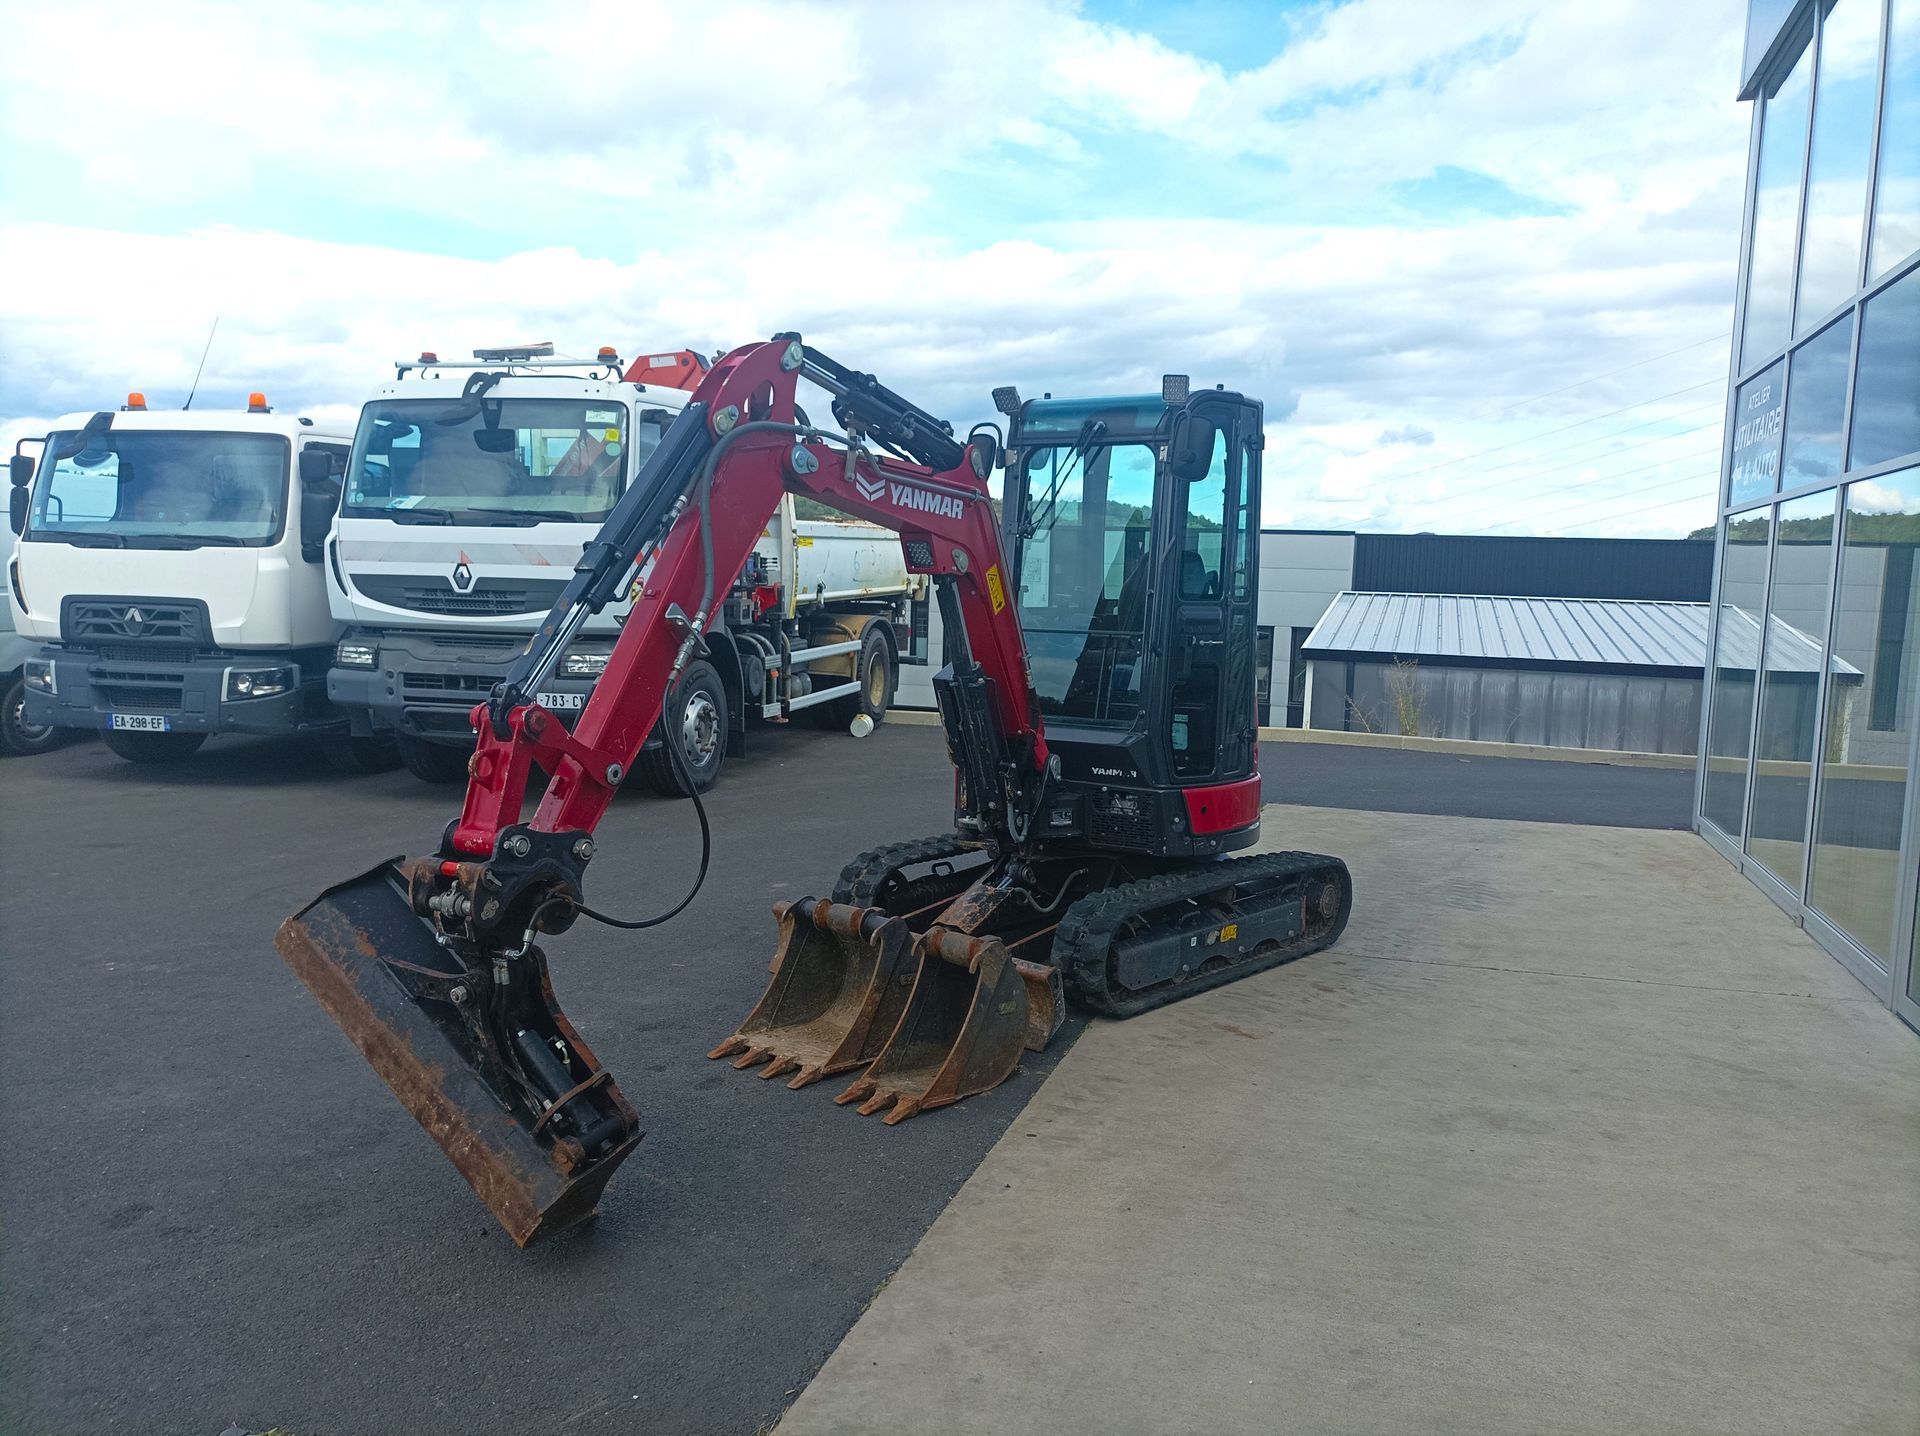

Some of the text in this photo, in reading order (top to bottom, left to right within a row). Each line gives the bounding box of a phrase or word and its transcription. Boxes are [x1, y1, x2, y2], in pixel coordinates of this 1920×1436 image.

[1734, 406, 1782, 452] UTILITAIRE
[1750, 449, 1777, 484] AUTO
[889, 482, 964, 520] YANMAR
[114, 715, 163, 729] EA-298-EF
